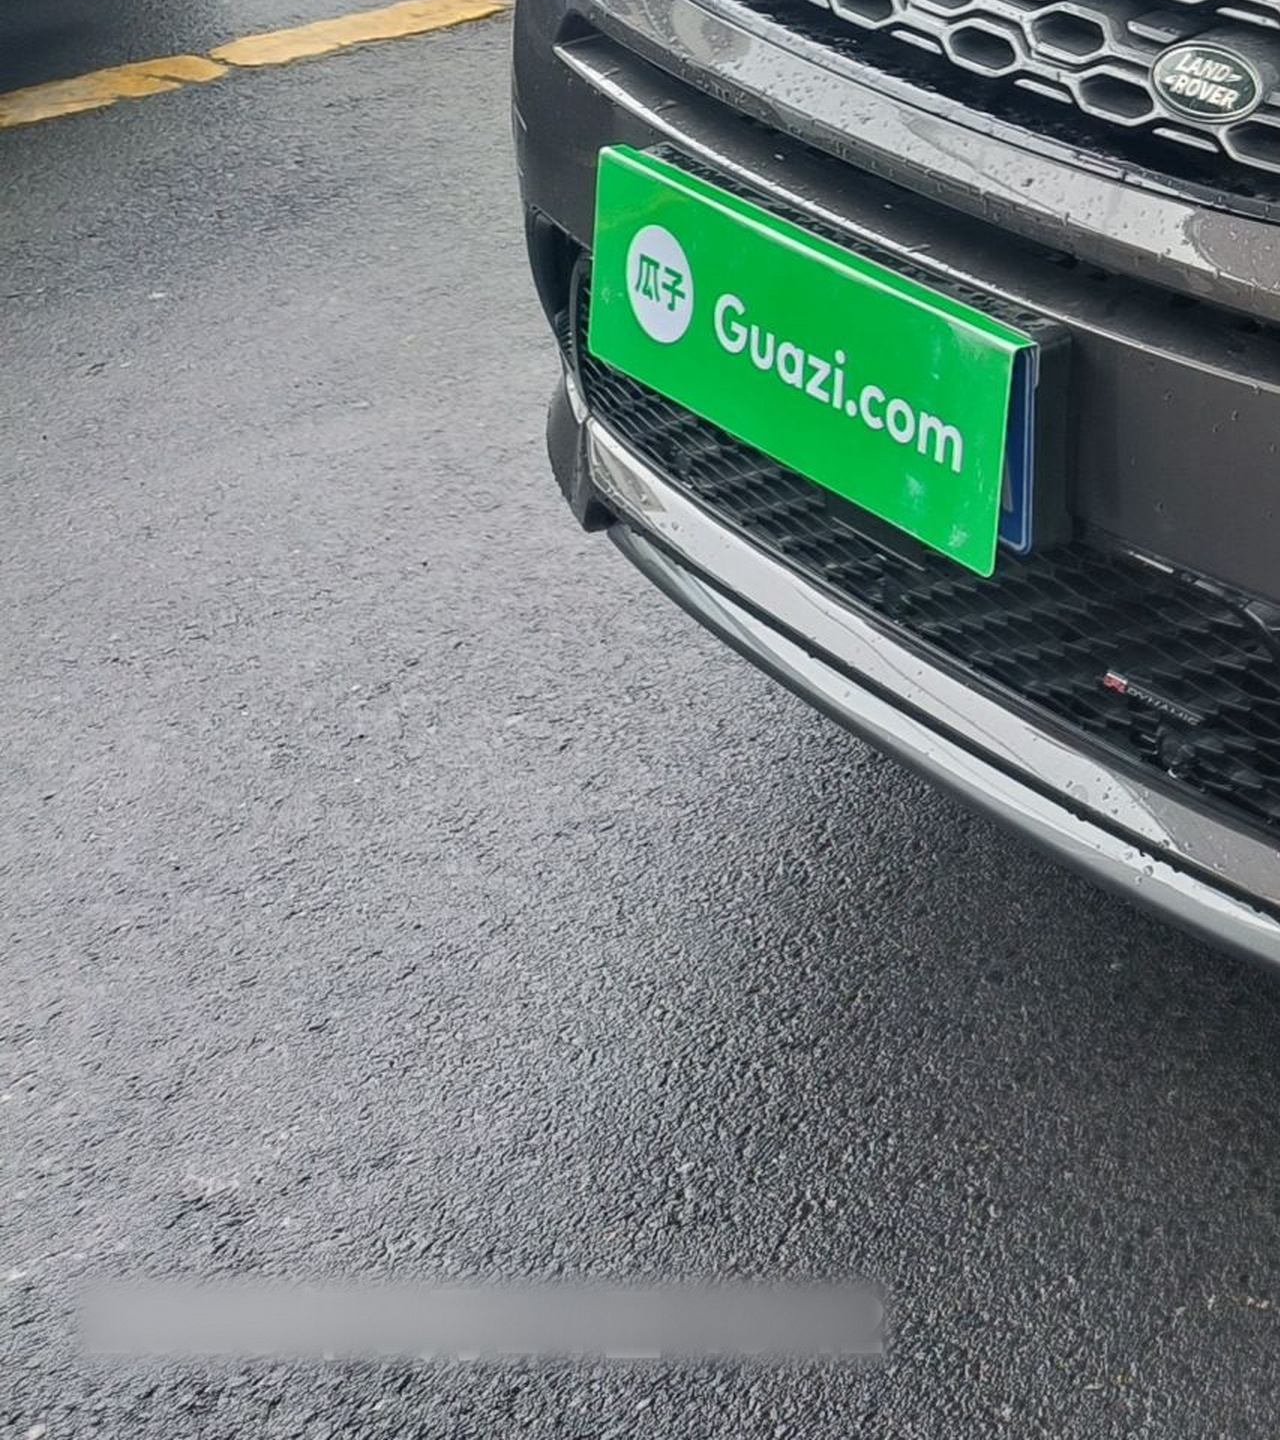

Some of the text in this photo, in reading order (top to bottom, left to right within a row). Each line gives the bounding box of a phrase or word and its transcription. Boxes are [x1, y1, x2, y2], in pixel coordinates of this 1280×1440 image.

[1175, 52, 1234, 82] LAND
[1169, 74, 1240, 110] ROVER
[634, 252, 686, 312] 瓜子
[713, 292, 964, 473] Guazi.com
